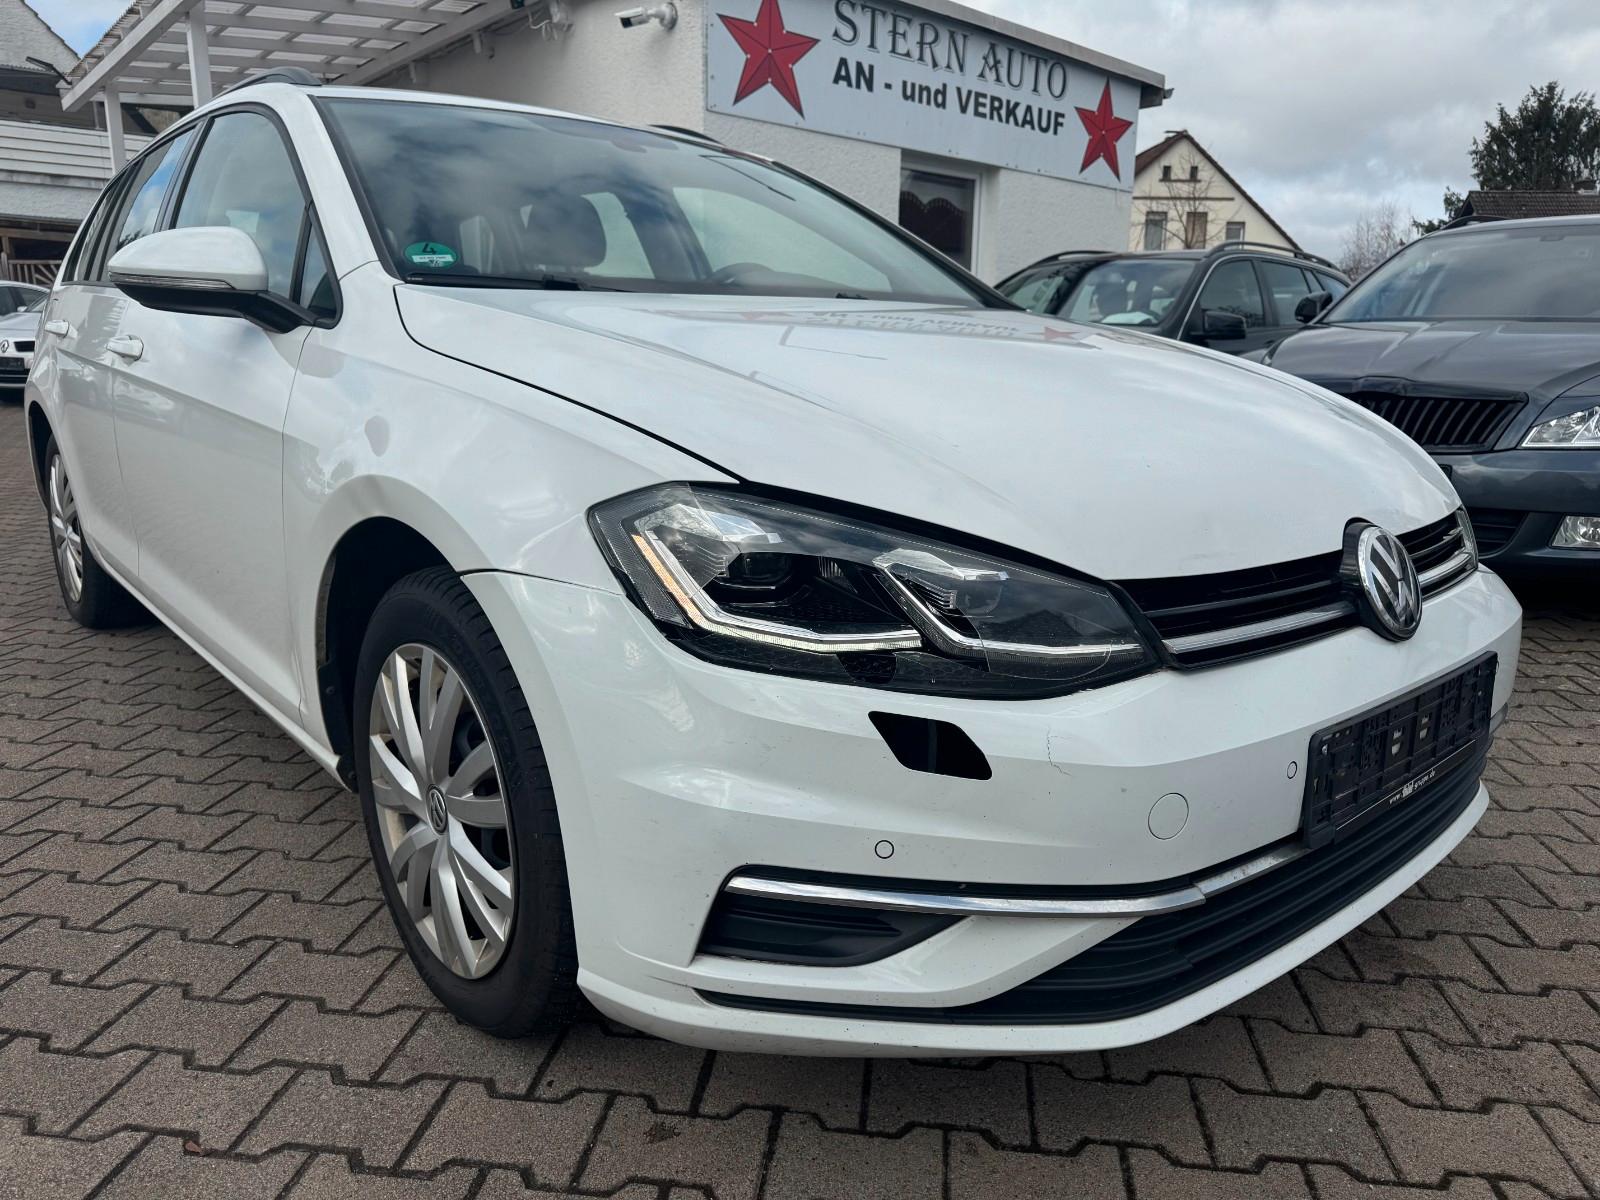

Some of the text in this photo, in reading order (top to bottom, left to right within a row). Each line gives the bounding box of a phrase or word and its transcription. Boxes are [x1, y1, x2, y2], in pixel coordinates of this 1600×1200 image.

[832, 0, 1068, 101] STERN AUTO
[832, 56, 875, 93] AN
[902, 80, 948, 110] und
[956, 86, 1066, 136] VERKAUF
